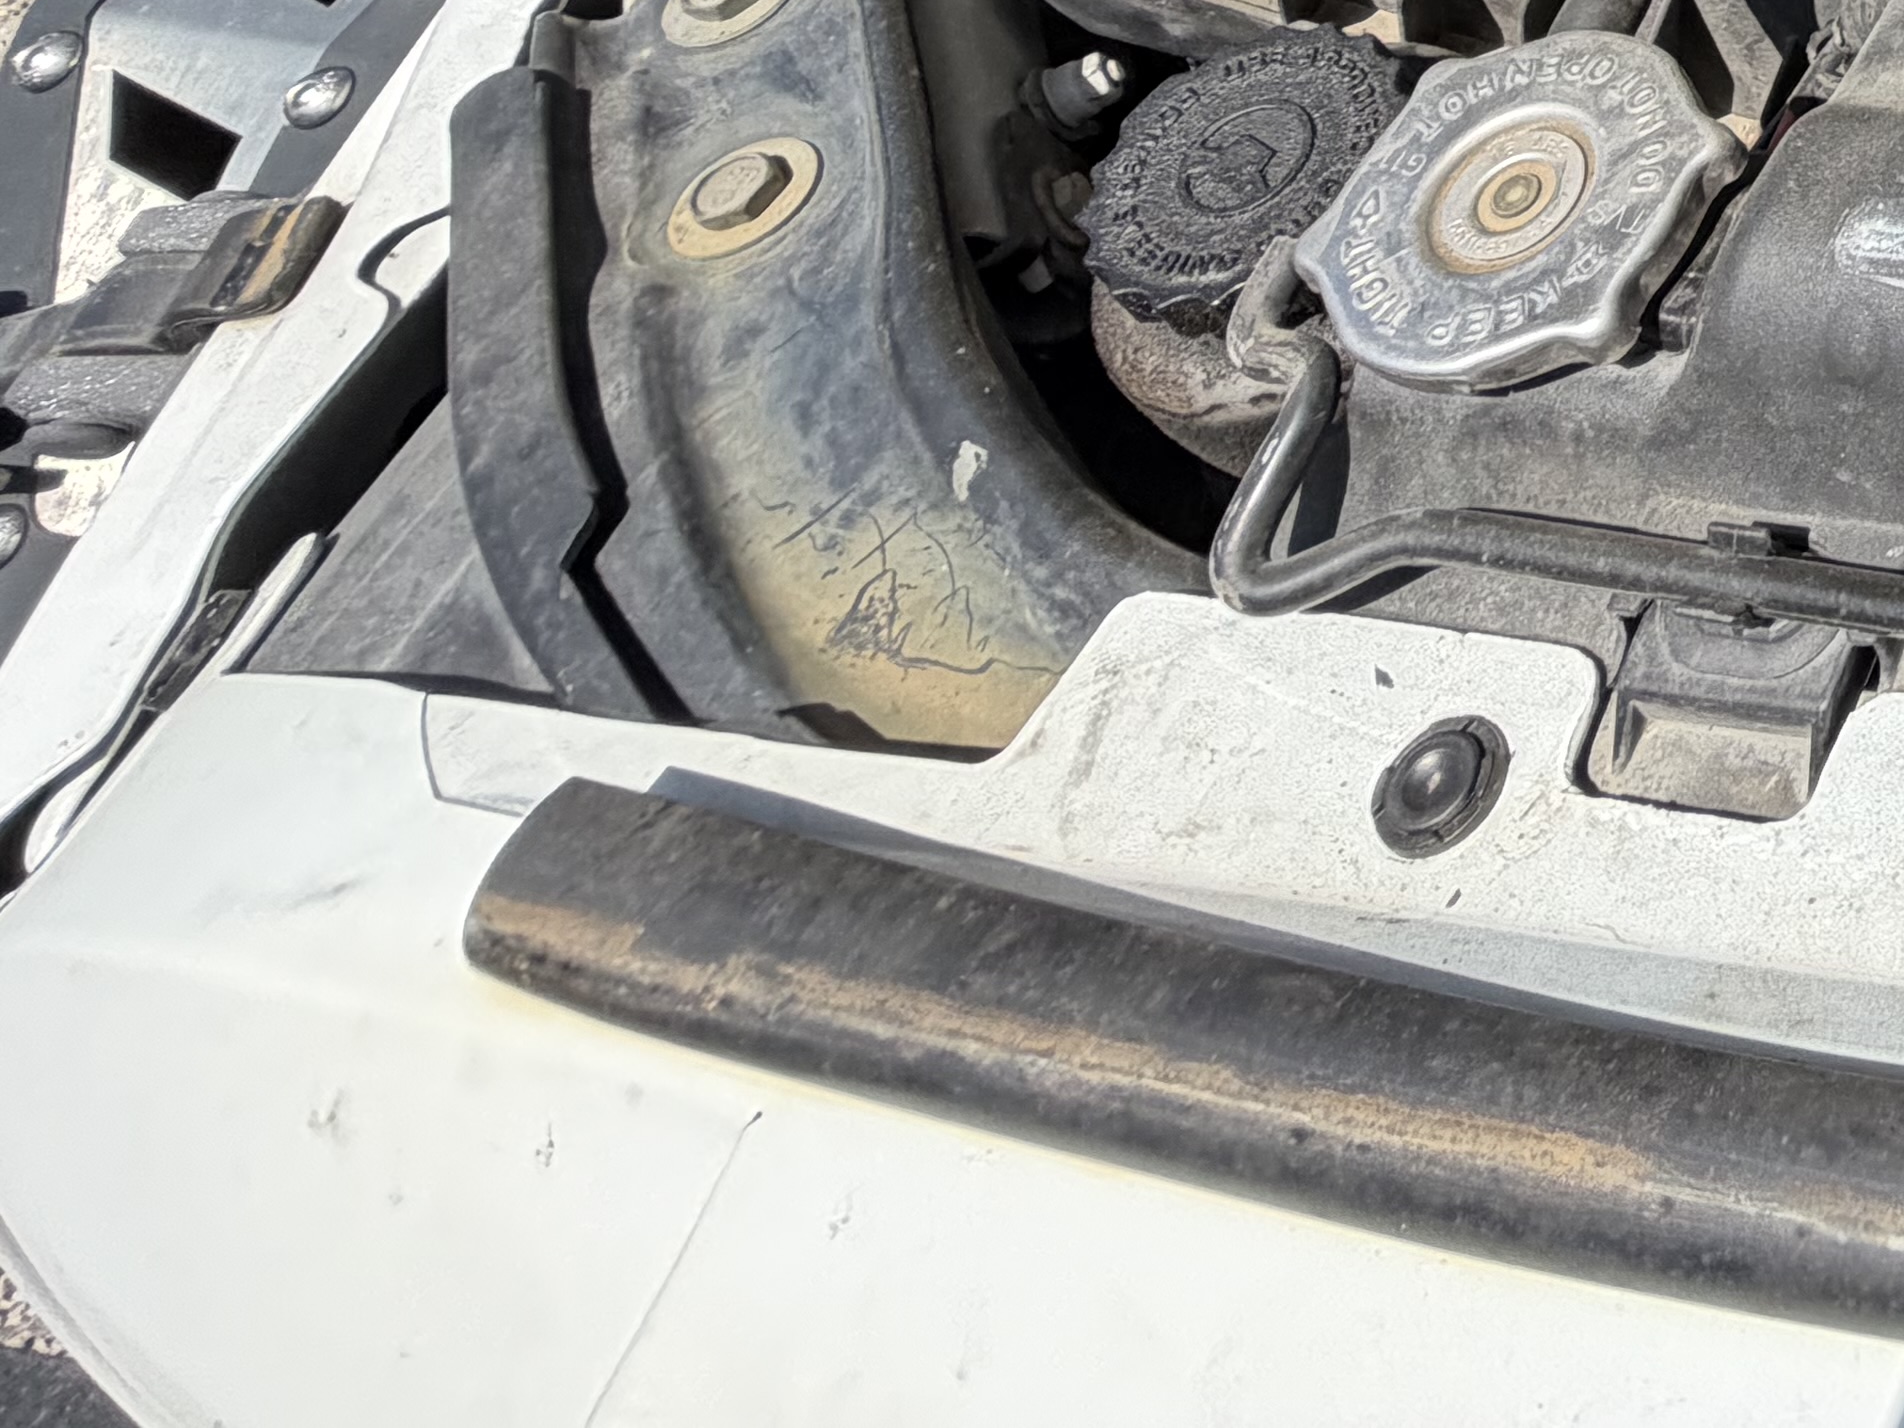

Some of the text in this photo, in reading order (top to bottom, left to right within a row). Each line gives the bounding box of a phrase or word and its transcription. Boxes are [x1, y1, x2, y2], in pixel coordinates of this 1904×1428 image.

[1410, 71, 1500, 138] HOT
[1504, 54, 1617, 90] OPEN
[1613, 71, 1667, 138] NOT
[1628, 140, 1670, 193] DO
[1339, 236, 1558, 347] KEEP TIGHT
